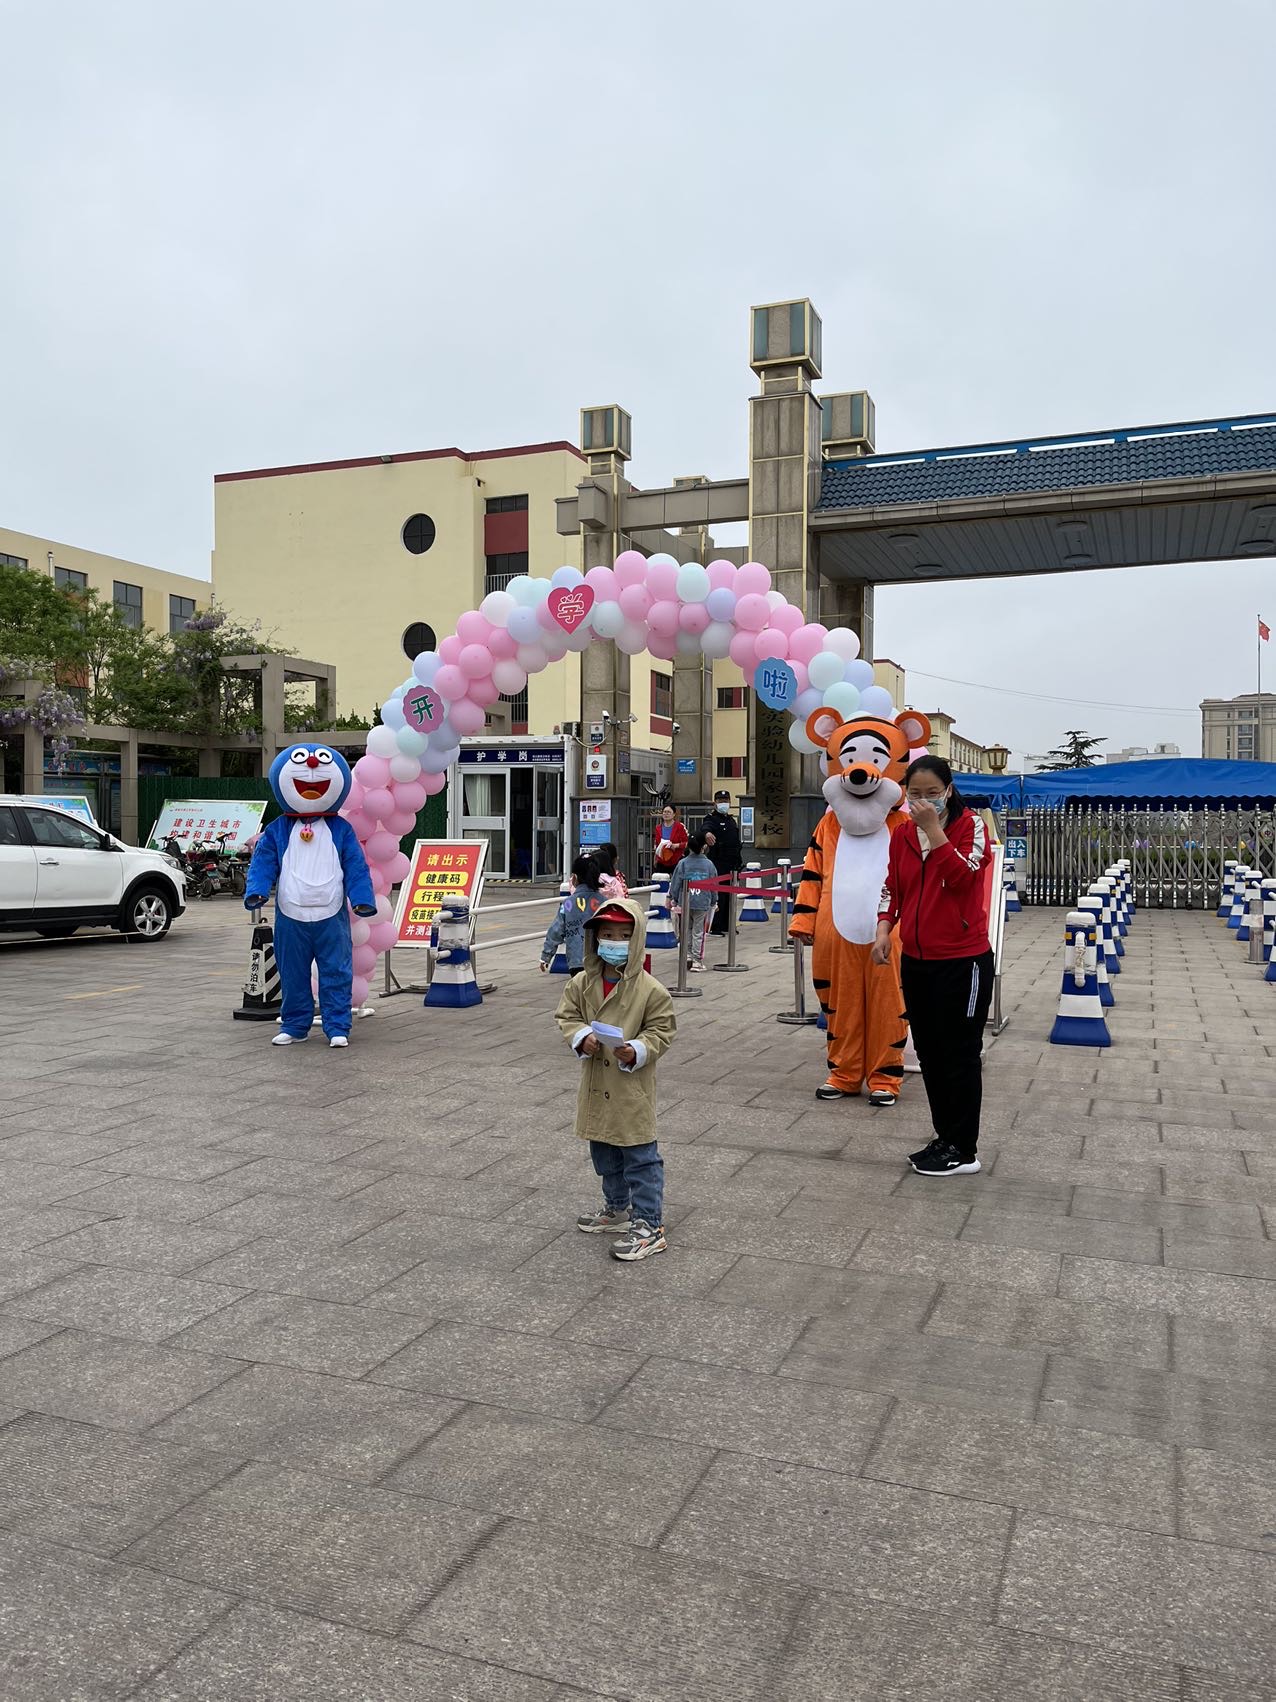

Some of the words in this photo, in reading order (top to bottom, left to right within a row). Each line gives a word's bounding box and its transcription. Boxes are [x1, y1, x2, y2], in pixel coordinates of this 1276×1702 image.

[557, 593, 584, 624] 学
[763, 669, 787, 700] 啦
[410, 694, 434, 725] 开
[476, 750, 528, 762] 护学岗
[172, 817, 242, 829] 建设卫生城市
[169, 830, 238, 841] 构建和谐园
[1008, 840, 1026, 848] 出入
[1008, 848, 1026, 857] 下车
[427, 853, 469, 866] 请出示
[425, 873, 461, 885] 健康码
[250, 952, 261, 993] 请勿泊车
